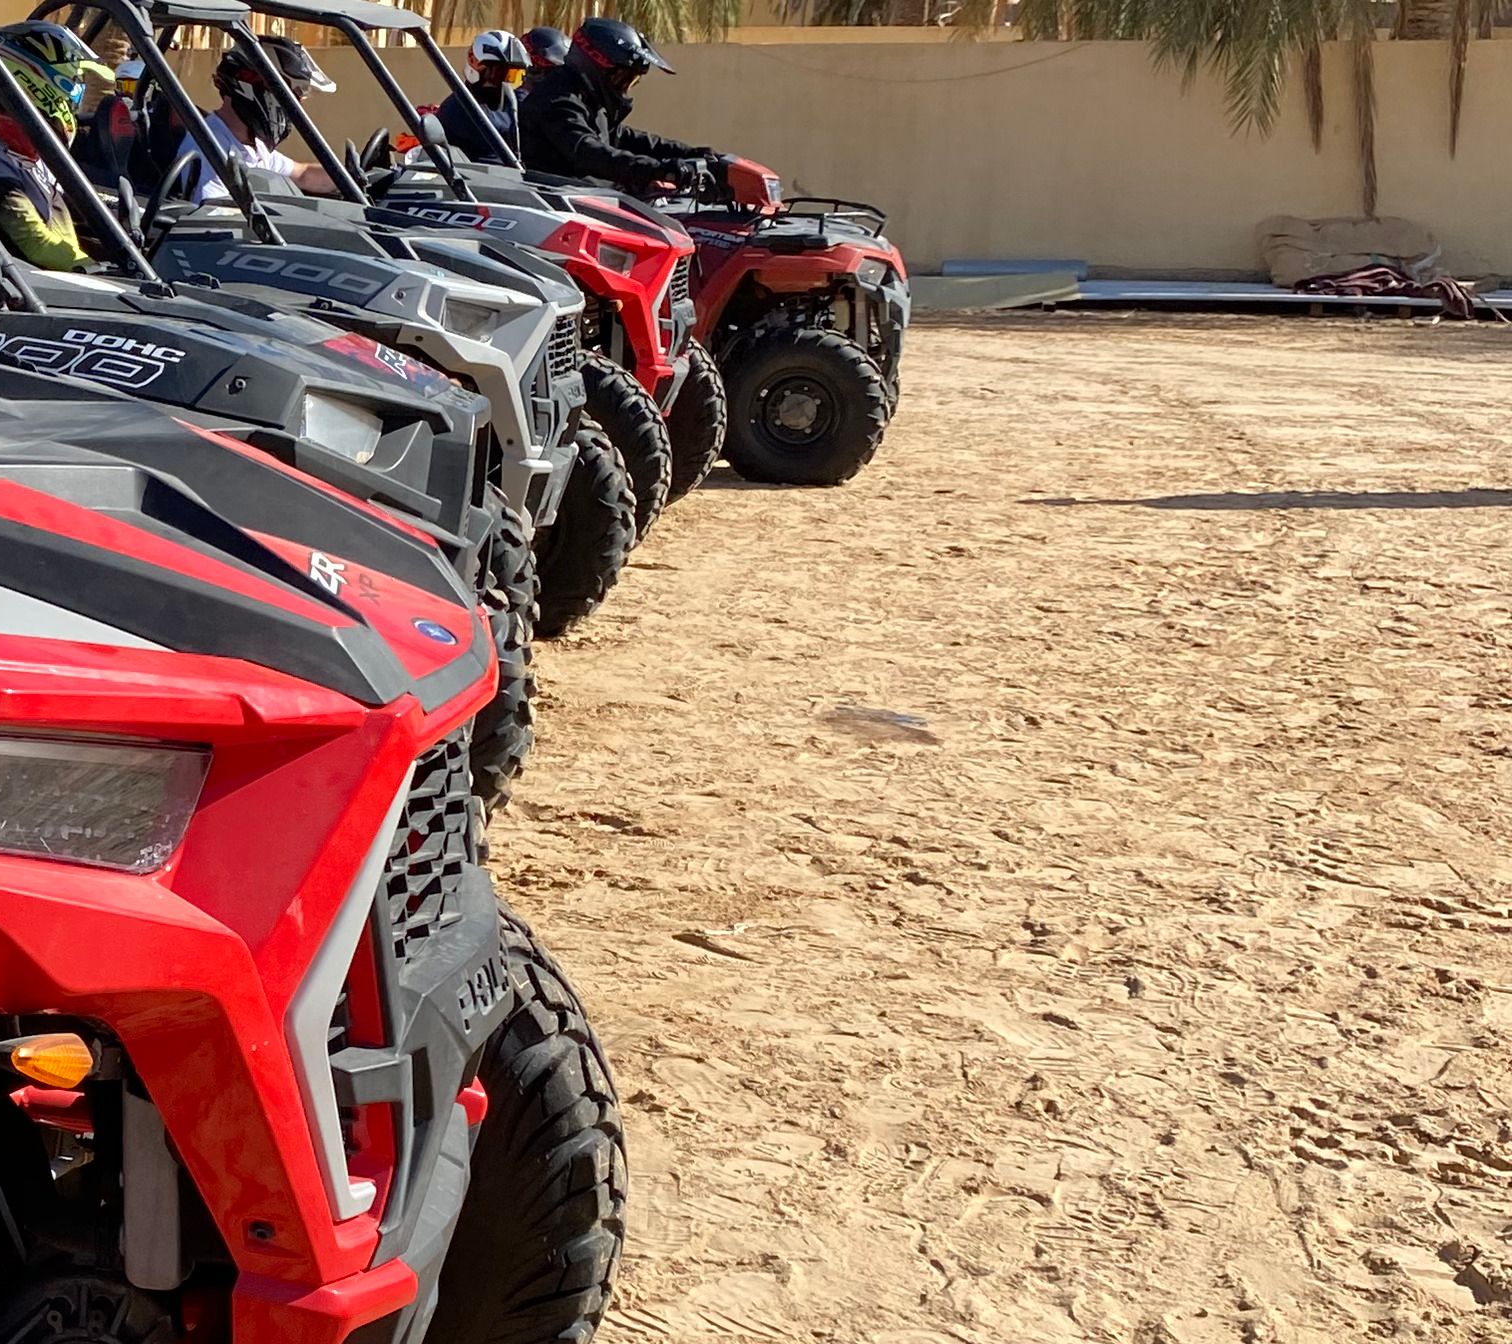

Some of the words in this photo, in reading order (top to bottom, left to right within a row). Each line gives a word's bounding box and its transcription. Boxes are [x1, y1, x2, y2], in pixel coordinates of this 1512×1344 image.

[407, 206, 518, 232] 1000
[215, 250, 385, 295] 1000
[62, 328, 186, 363] DOHC
